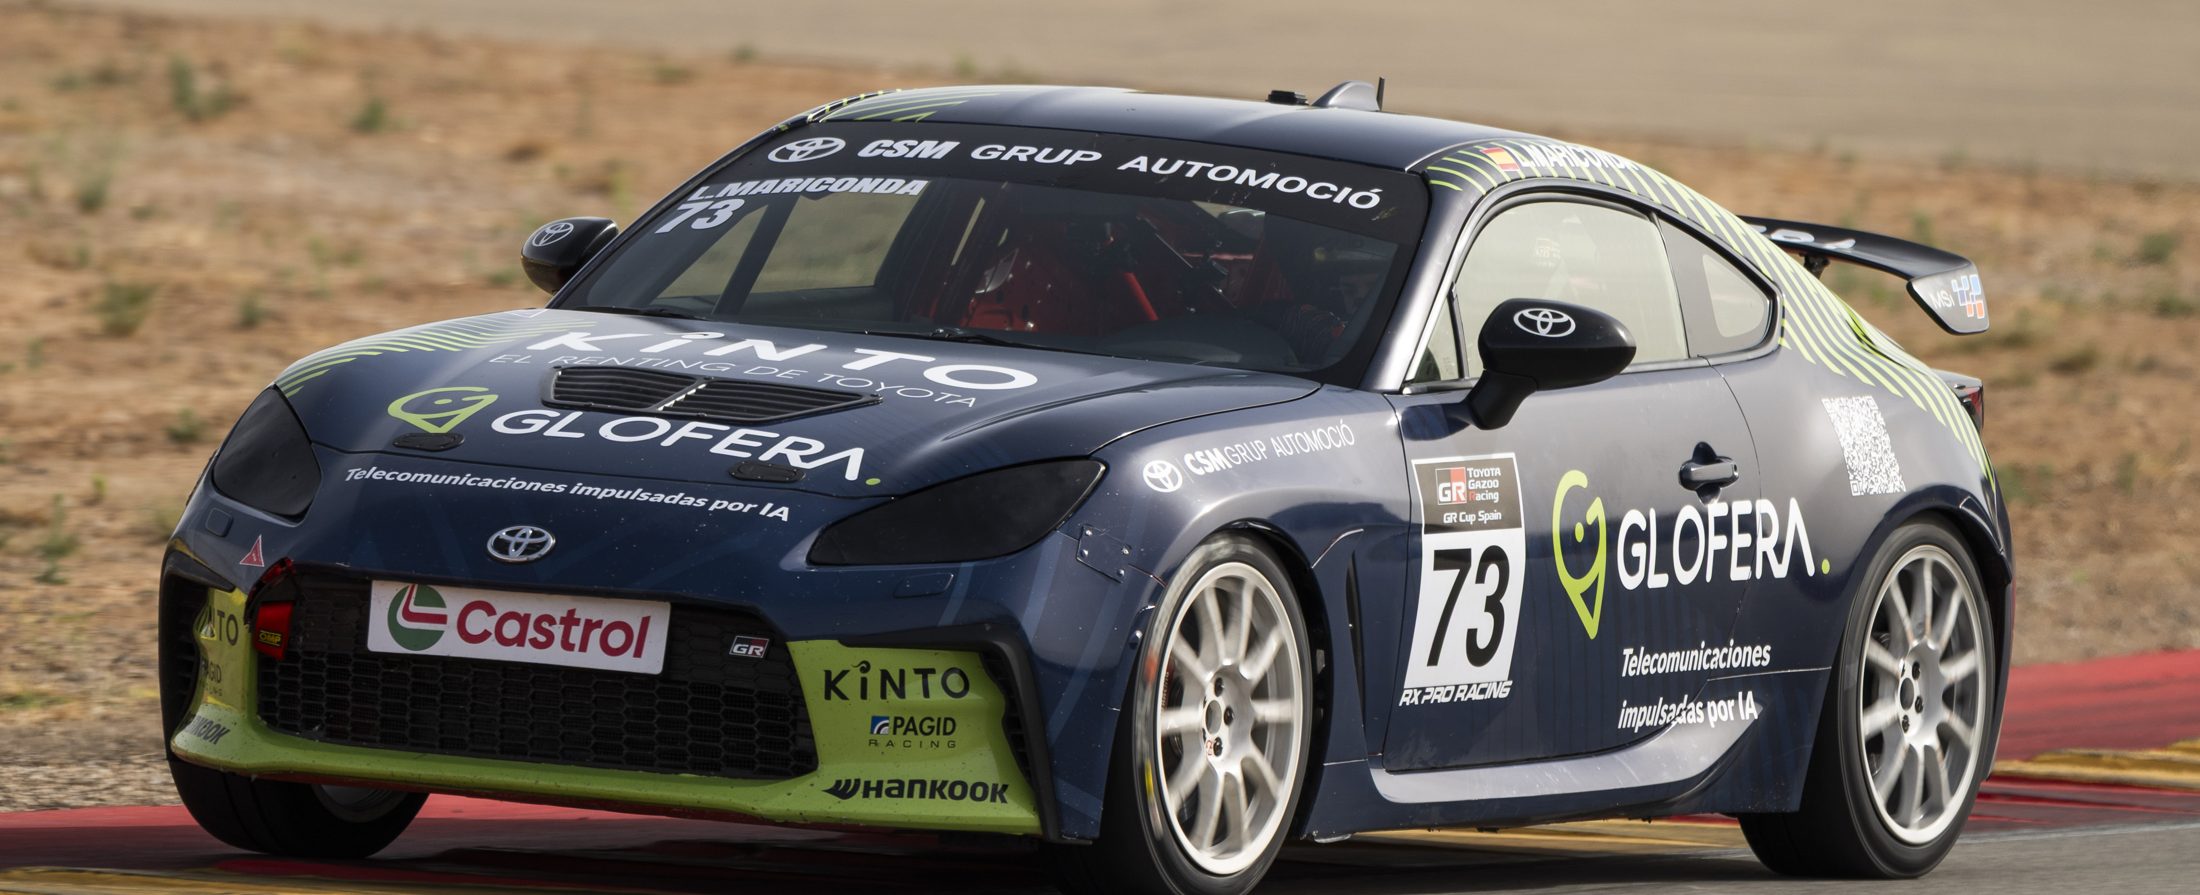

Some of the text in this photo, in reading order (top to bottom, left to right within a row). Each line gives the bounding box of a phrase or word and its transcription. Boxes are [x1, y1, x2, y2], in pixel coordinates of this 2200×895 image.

[857, 139, 1382, 210] CSM GRUP AUTOMOCIÓ
[687, 176, 930, 202] L.MARICONDA
[655, 198, 746, 235] 73
[489, 354, 977, 408] EL RENTING DE TOYOTA
[1270, 418, 1356, 458] AUTOMOCIÓ
[1467, 467, 1501, 478] TOYOTA
[1468, 479, 1500, 490] GAZOO
[344, 465, 790, 522] Telecomunicaciones impulsadas por IA
[1438, 482, 1466, 502] GR
[1469, 490, 1500, 503] Racing
[1443, 509, 1502, 525] GR Cup Spain
[1426, 544, 1510, 668] 73
[456, 599, 652, 660] Castrol
[731, 642, 765, 657] GR
[1621, 640, 1772, 677] Telecomunicaciones
[1398, 680, 1513, 707] RX PRO RACING
[1617, 690, 1759, 733] impulsadas por IA
[892, 716, 957, 737] PAGID
[868, 738, 957, 749] RACING
